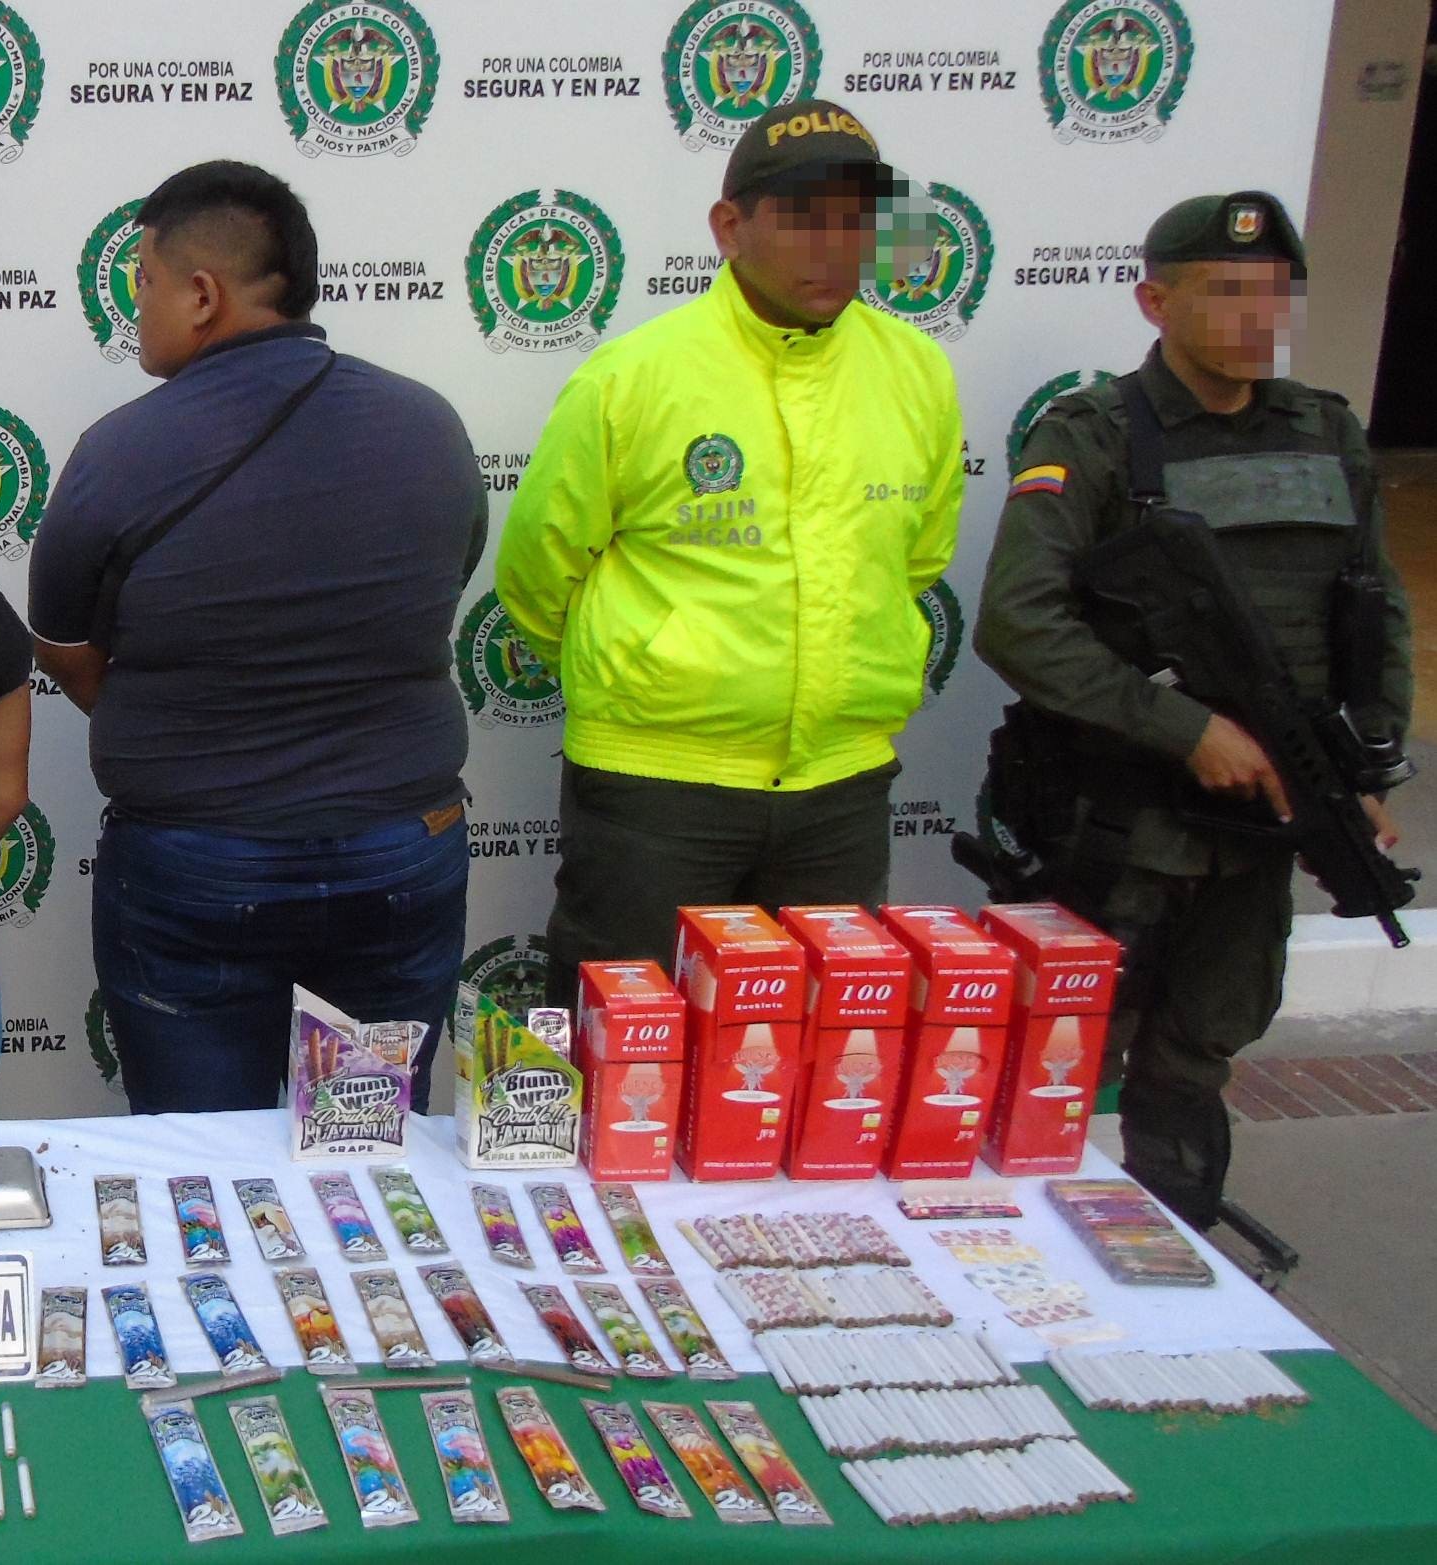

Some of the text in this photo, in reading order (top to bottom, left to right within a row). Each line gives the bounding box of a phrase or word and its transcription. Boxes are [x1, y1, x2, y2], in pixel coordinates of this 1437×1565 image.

[864, 51, 999, 68] POR UNA COLOMBIA
[90, 61, 234, 78] POR UNA COLOMBIA
[844, 72, 1016, 92] SEGURA Y EN PAZ
[70, 83, 252, 104] SEGURA Y EN PAZ
[766, 111, 877, 153] POLIC
[540, 208, 557, 217] DE
[569, 215, 605, 279] COLOMBIA
[1034, 246, 1141, 261] POR UNA COLOM
[319, 262, 426, 278] UNA COLOMBIA
[666, 256, 693, 271] POR
[1015, 265, 1139, 286] SEGURA Y EN
[355, 283, 368, 301] Y
[375, 283, 400, 300] EN
[408, 282, 443, 300] PAZ
[647, 276, 712, 295] SEGUR
[544, 294, 599, 333] NACIONAL
[503, 331, 530, 346] DIOS
[543, 330, 583, 348] PATRIA
[963, 459, 985, 475] AZ
[676, 498, 756, 525] SIJIN
[493, 820, 521, 835] UNA
[893, 817, 956, 836] EN PAZ
[469, 838, 538, 858] GURA Y
[734, 978, 788, 997] 100
[946, 982, 998, 999] 100
[1048, 973, 1099, 990] 100
[839, 983, 893, 1001] 100
[621, 1024, 671, 1041] 100
[0, 1034, 66, 1053] EN PAZ
[331, 1077, 391, 1096] Blunt
[506, 1073, 560, 1092] Blunt
[337, 1088, 398, 1110] Wrap
[513, 1087, 571, 1110] Wrap
[302, 1113, 404, 1149] PLATINUM
[478, 1113, 578, 1156] PLATINUM
[328, 1144, 374, 1153] GRAPE
[482, 1150, 567, 1162] APPLE MARTINI
